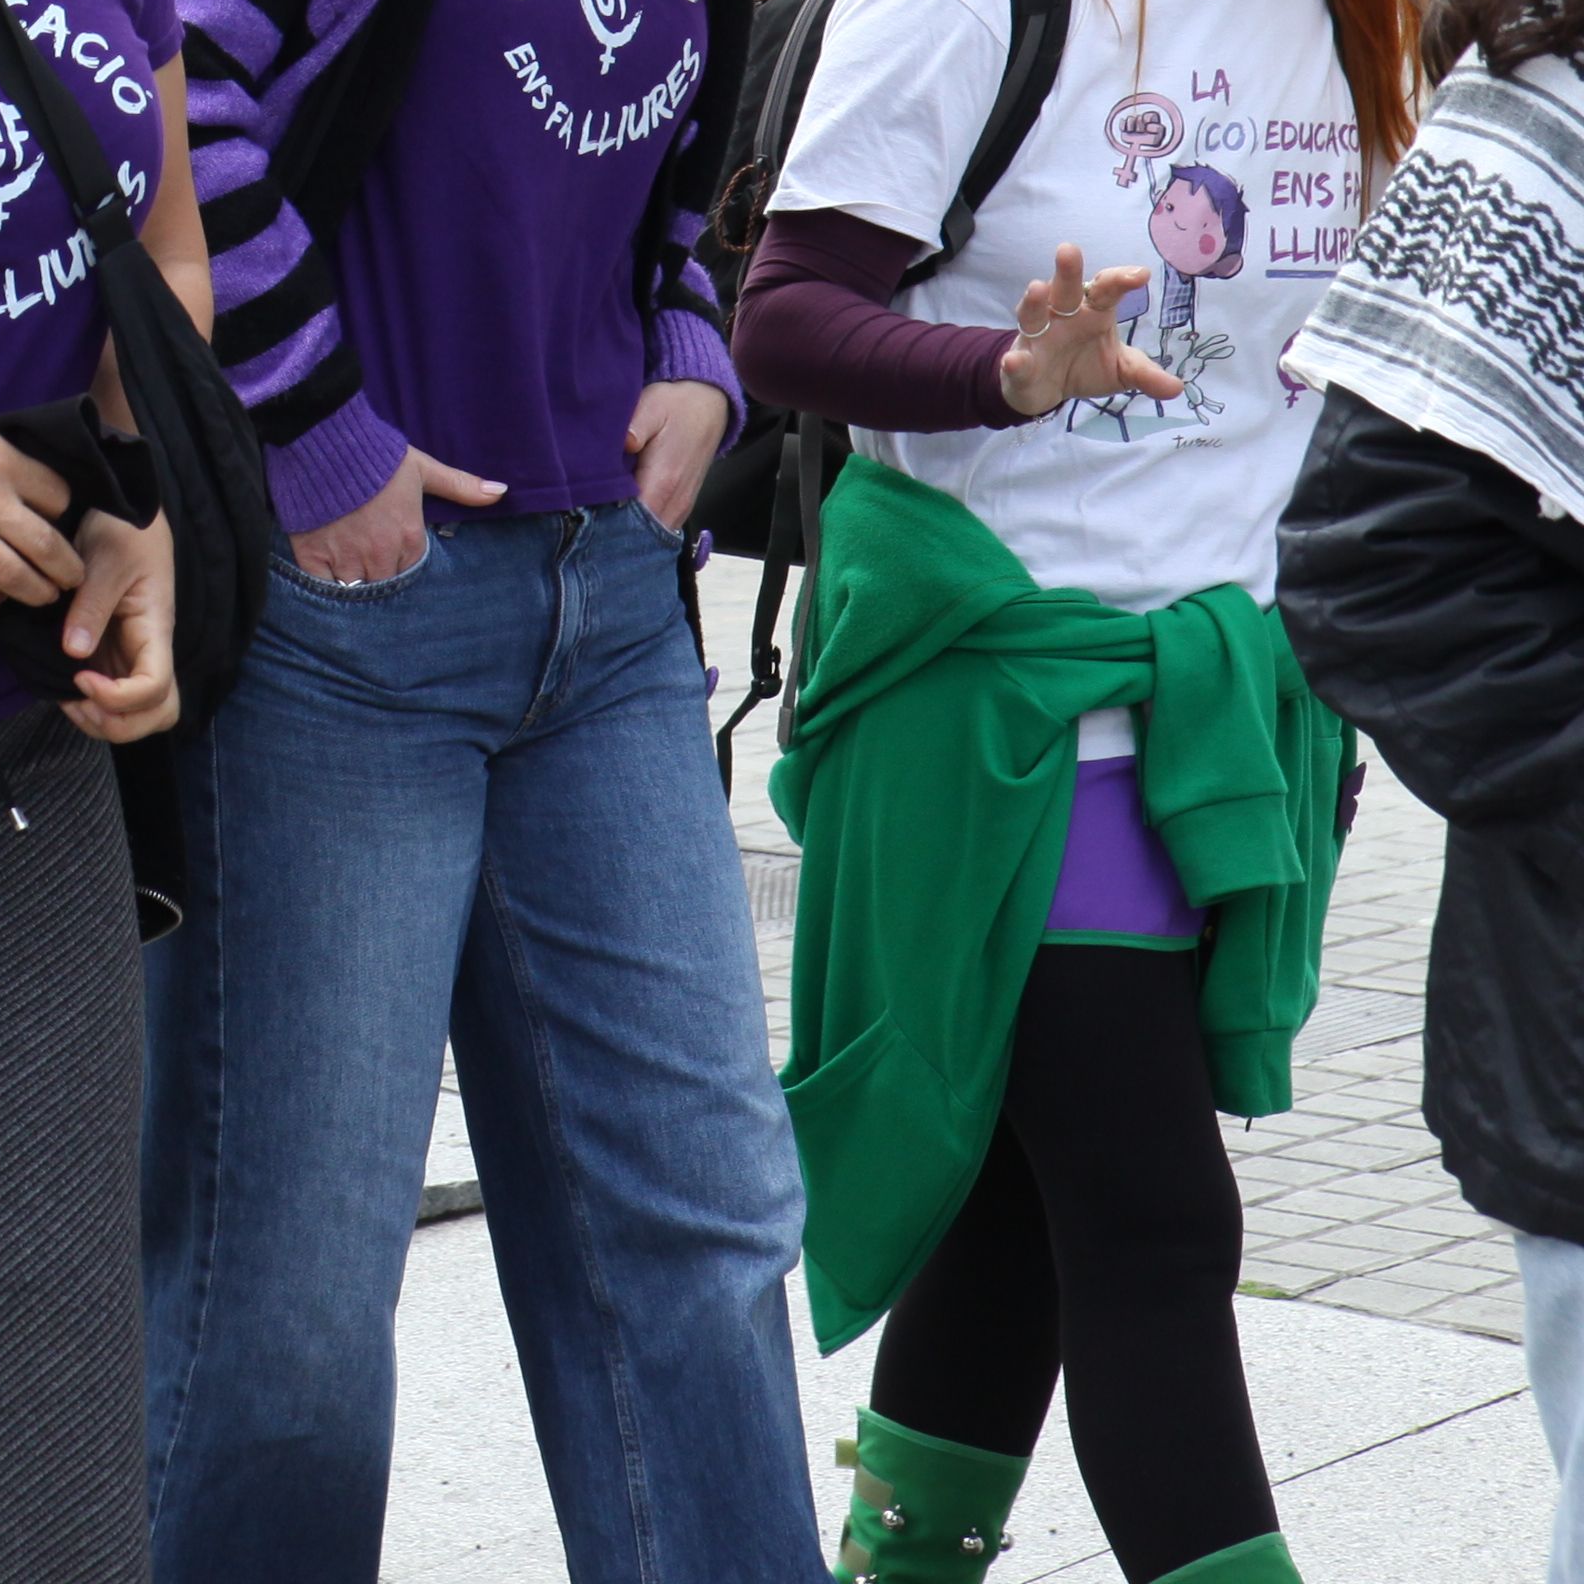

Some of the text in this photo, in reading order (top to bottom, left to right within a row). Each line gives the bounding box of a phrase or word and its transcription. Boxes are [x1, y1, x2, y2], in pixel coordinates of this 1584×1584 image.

[504, 38, 700, 157] ENS FA LLIURES
[1191, 69, 1230, 106] LA
[1271, 171, 1335, 208] ENS
